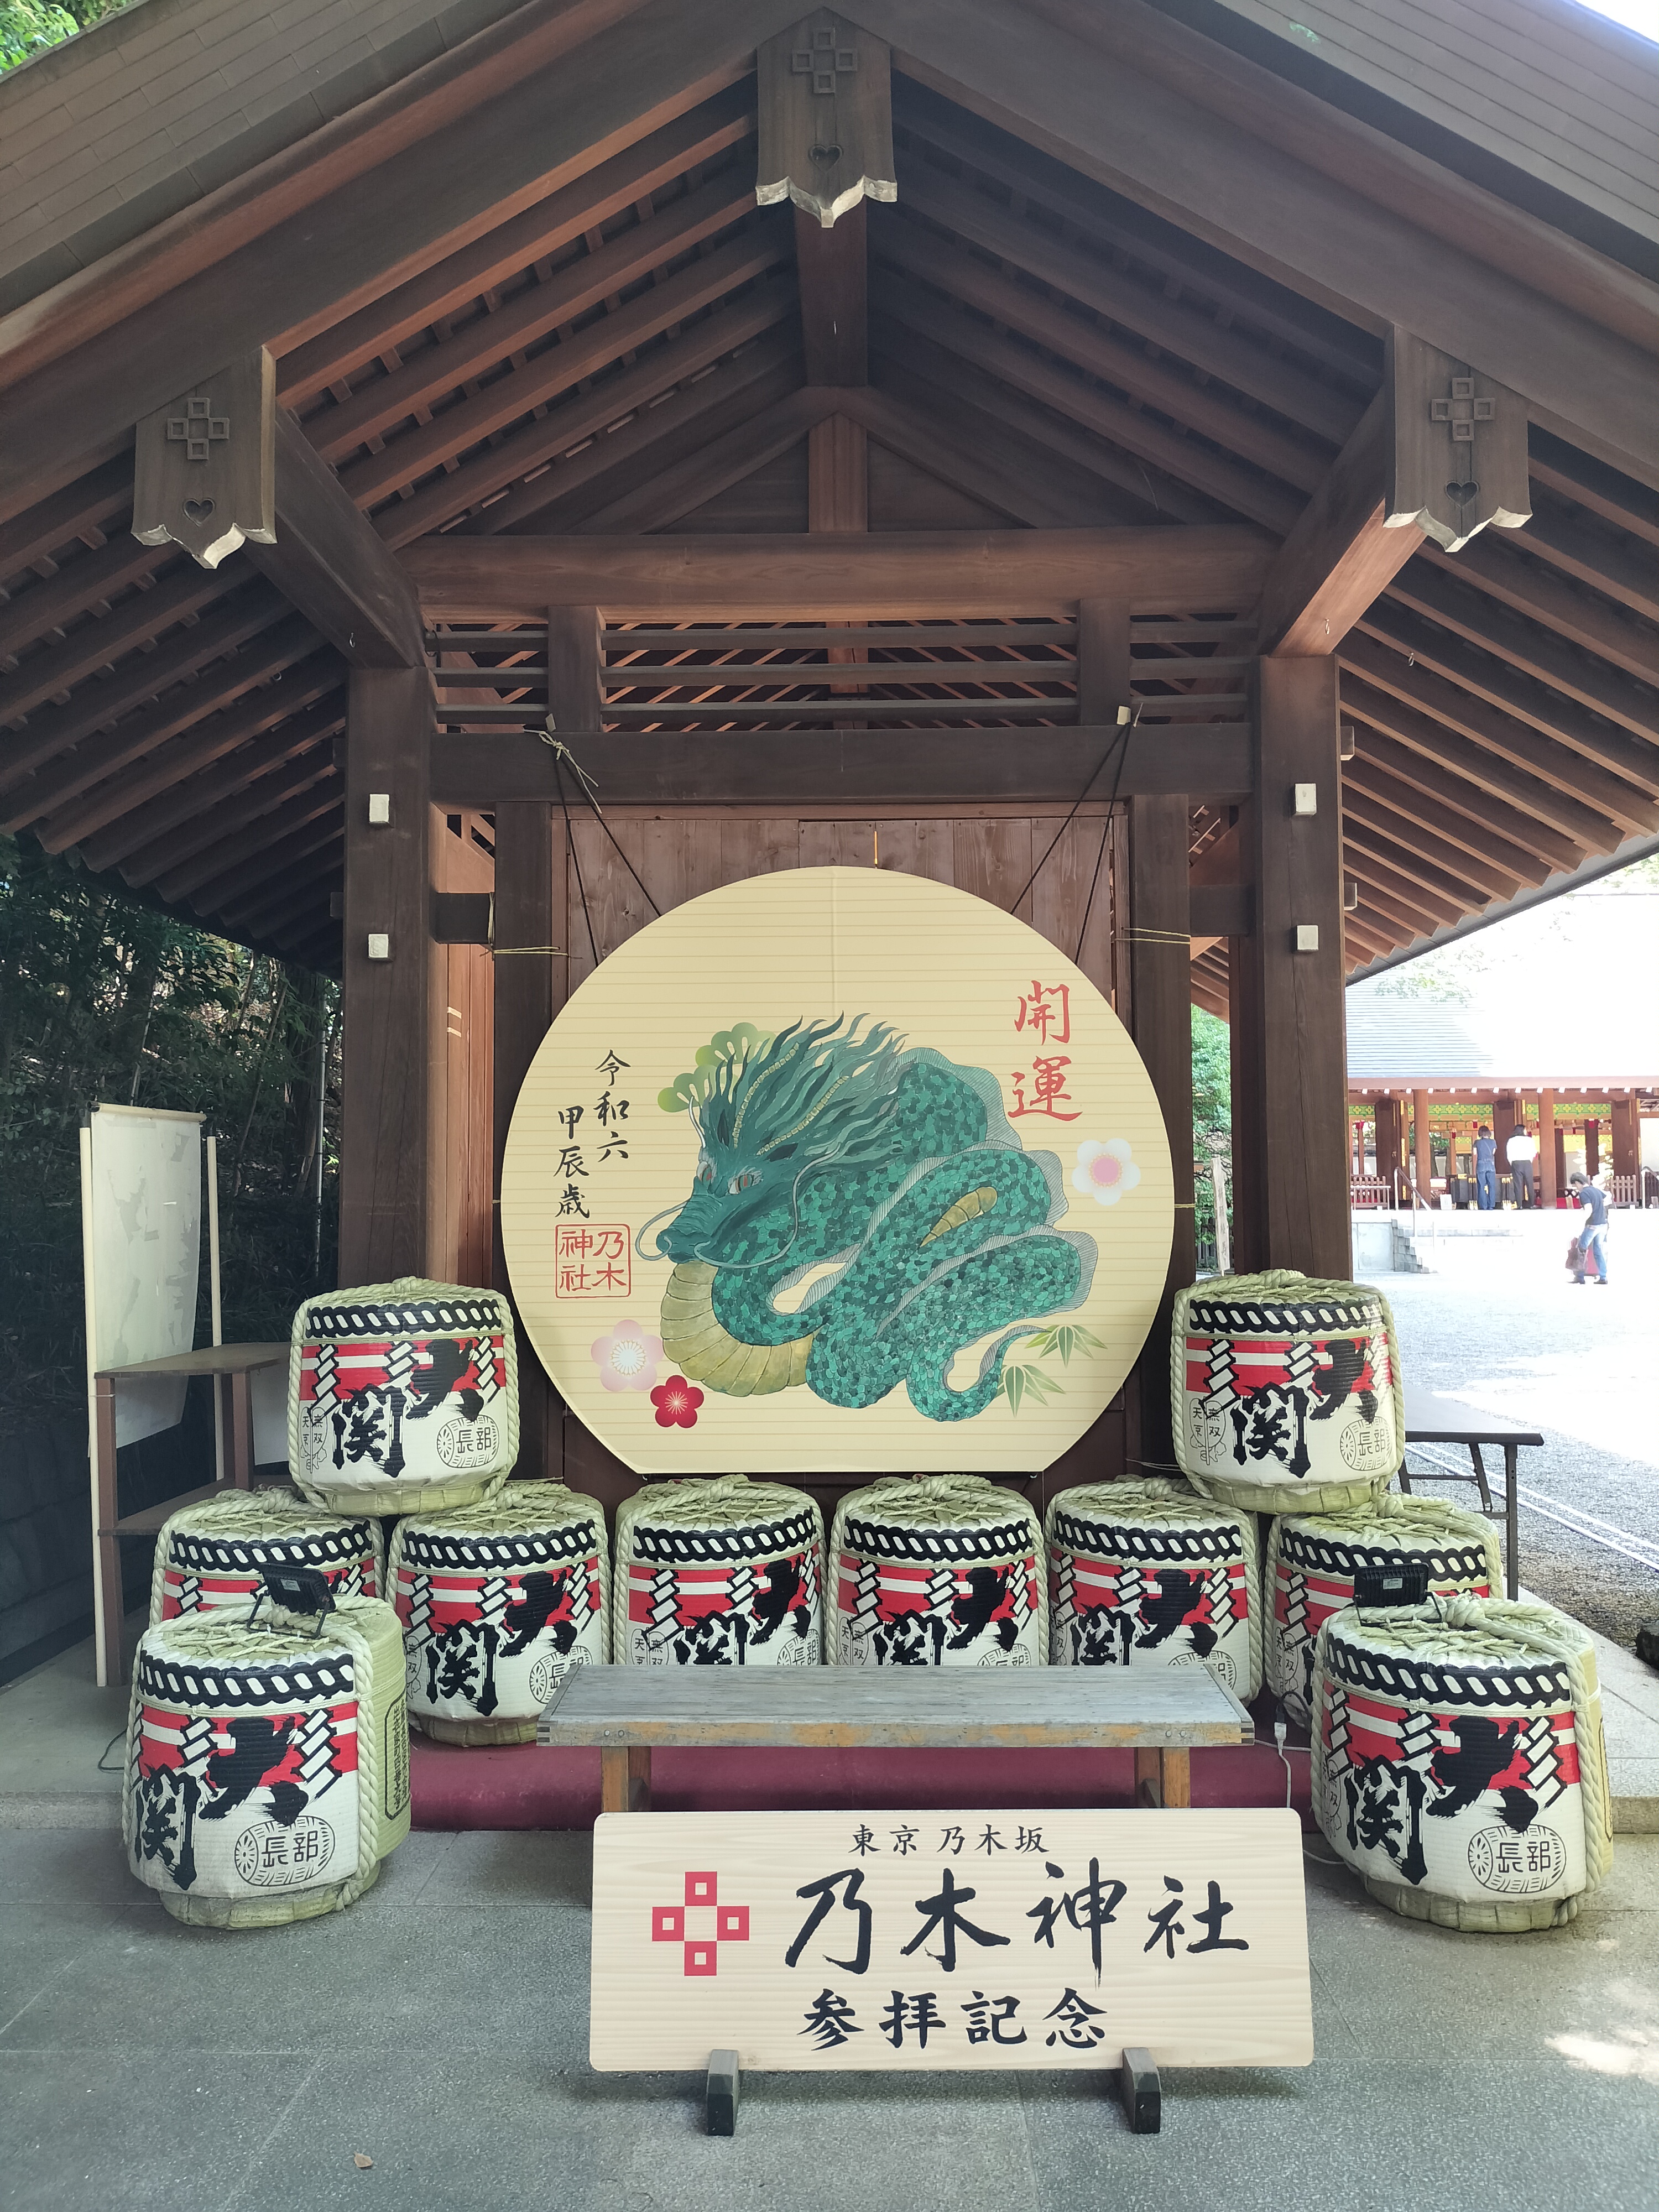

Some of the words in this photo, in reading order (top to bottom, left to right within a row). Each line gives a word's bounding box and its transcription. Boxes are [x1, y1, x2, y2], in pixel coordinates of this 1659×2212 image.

[1008, 980, 1083, 1121] 開運
[593, 1049, 631, 1162] 令和六
[554, 1105, 590, 1218] 甲辰歳
[456, 1427, 492, 1455] 長部
[1358, 1428, 1386, 1456] 長部
[261, 1830, 319, 1868] 長部
[848, 1824, 920, 1856] 東京
[936, 1824, 1050, 1856] 乃木坂
[1496, 1840, 1551, 1873] 長部
[784, 1857, 1249, 1990] 乃木神社
[796, 1987, 1108, 2051] 参拝記念
